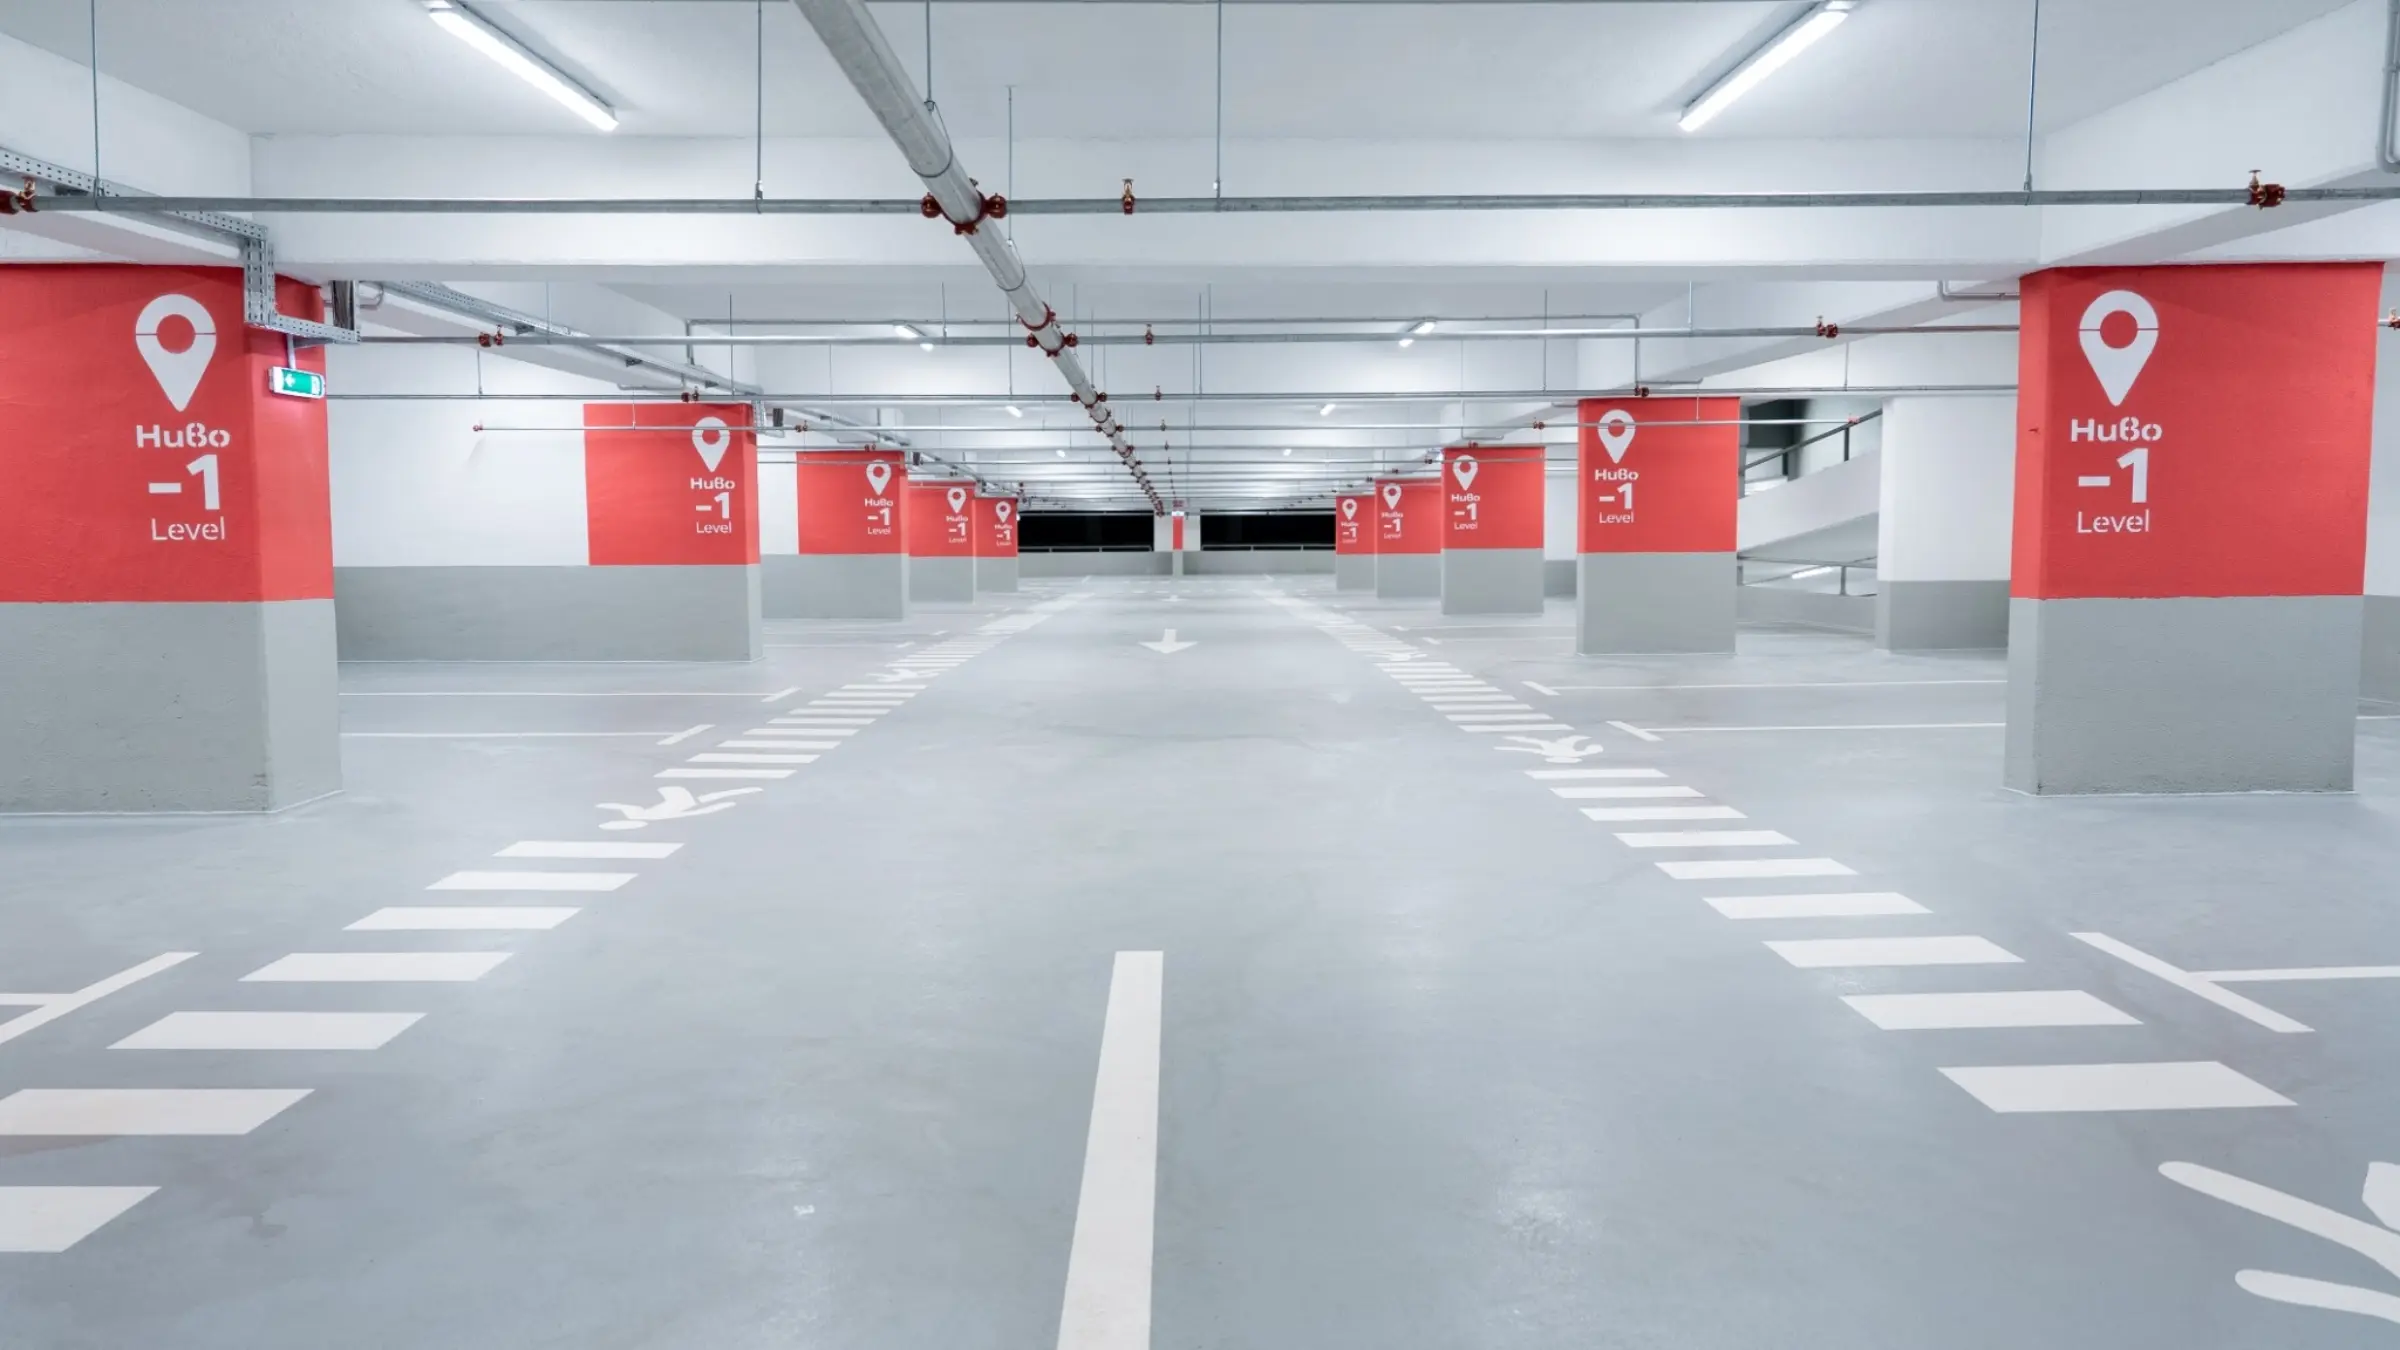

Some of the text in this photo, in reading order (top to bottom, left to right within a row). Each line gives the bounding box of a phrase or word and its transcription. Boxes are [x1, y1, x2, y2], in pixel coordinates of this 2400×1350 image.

[148, 454, 220, 510] -1
[2078, 448, 2149, 504] -1
[695, 491, 730, 519] -1
[1599, 482, 1633, 510] -1
[867, 508, 890, 526] -1
[1454, 502, 1477, 521] -1
[1599, 511, 1635, 524] Level
[151, 515, 226, 541] Level
[696, 521, 732, 534] Level
[867, 527, 891, 535] Level
[948, 522, 966, 537] -1
[1383, 518, 1401, 533] -1
[2077, 509, 2150, 534] Level
